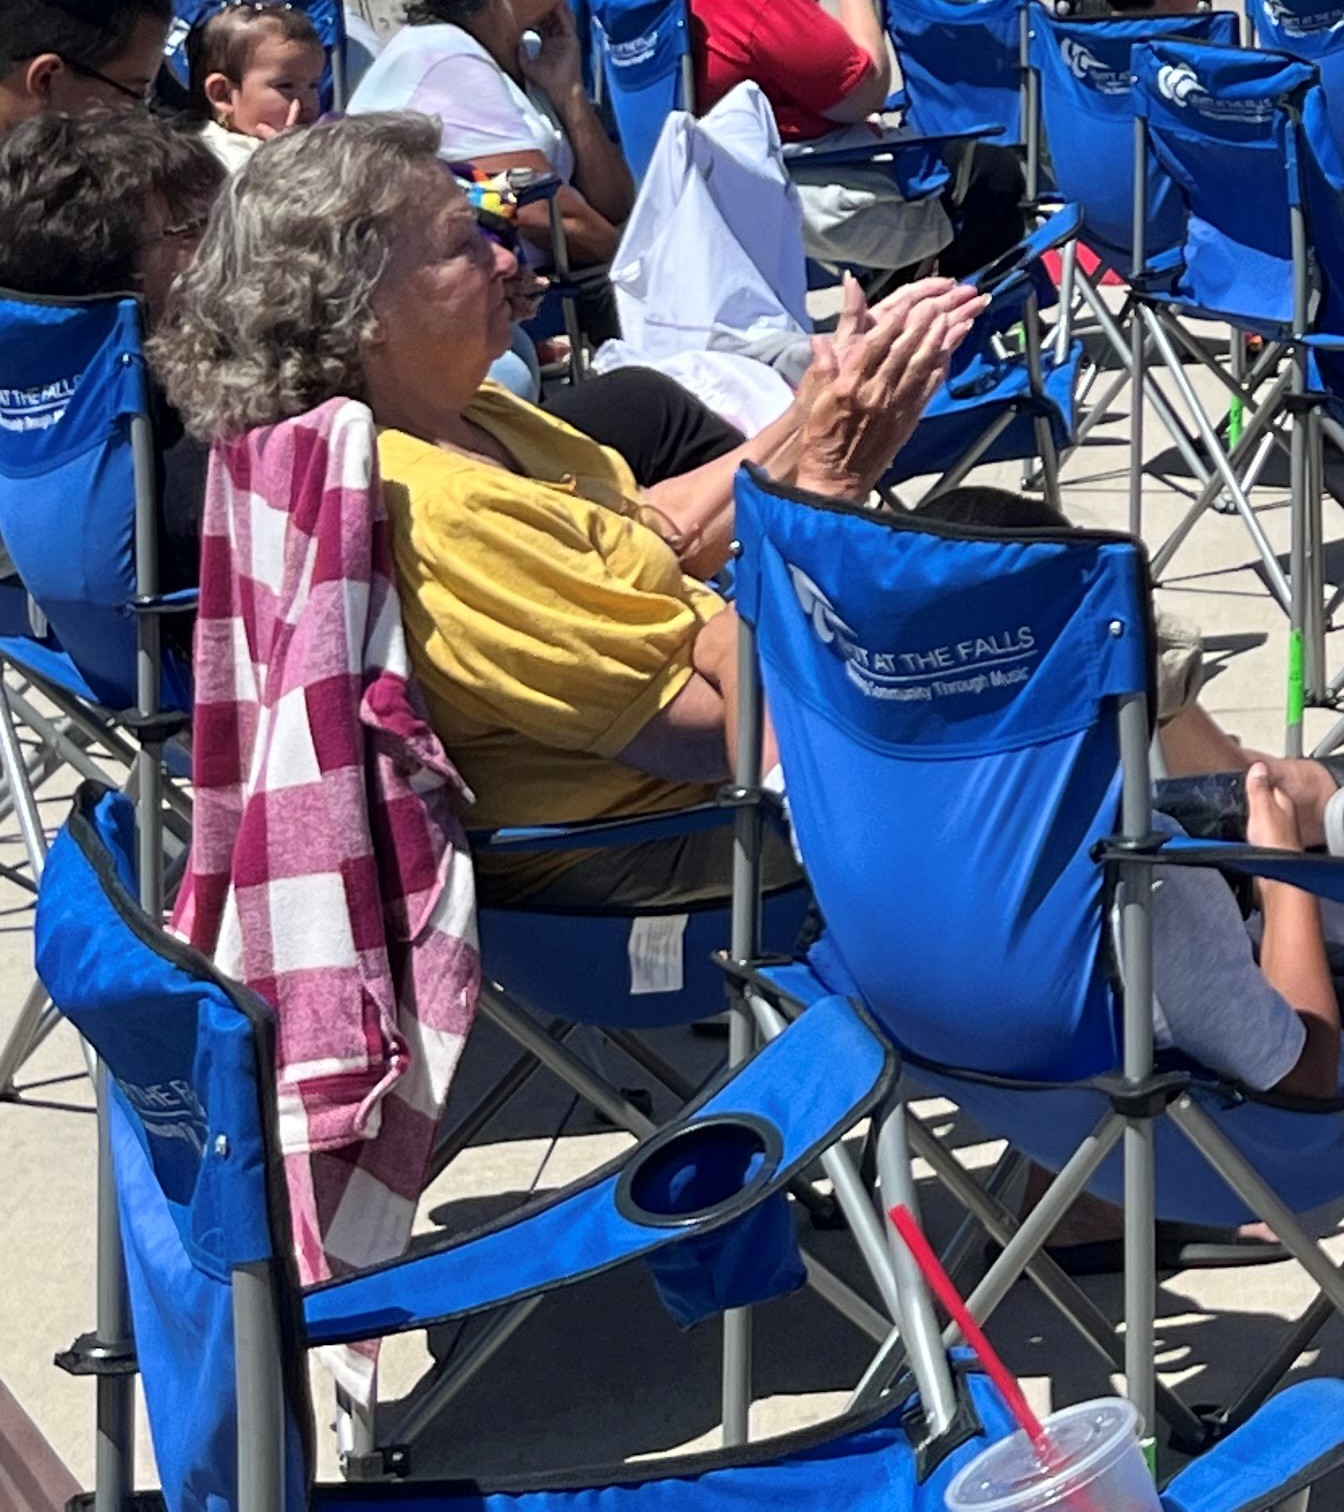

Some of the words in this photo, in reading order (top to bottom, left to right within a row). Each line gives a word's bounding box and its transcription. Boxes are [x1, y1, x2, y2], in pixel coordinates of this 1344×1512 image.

[874, 653, 896, 673] AT
[901, 646, 955, 672] THE
[957, 626, 1036, 660] FALLS
[932, 674, 989, 694] Through
